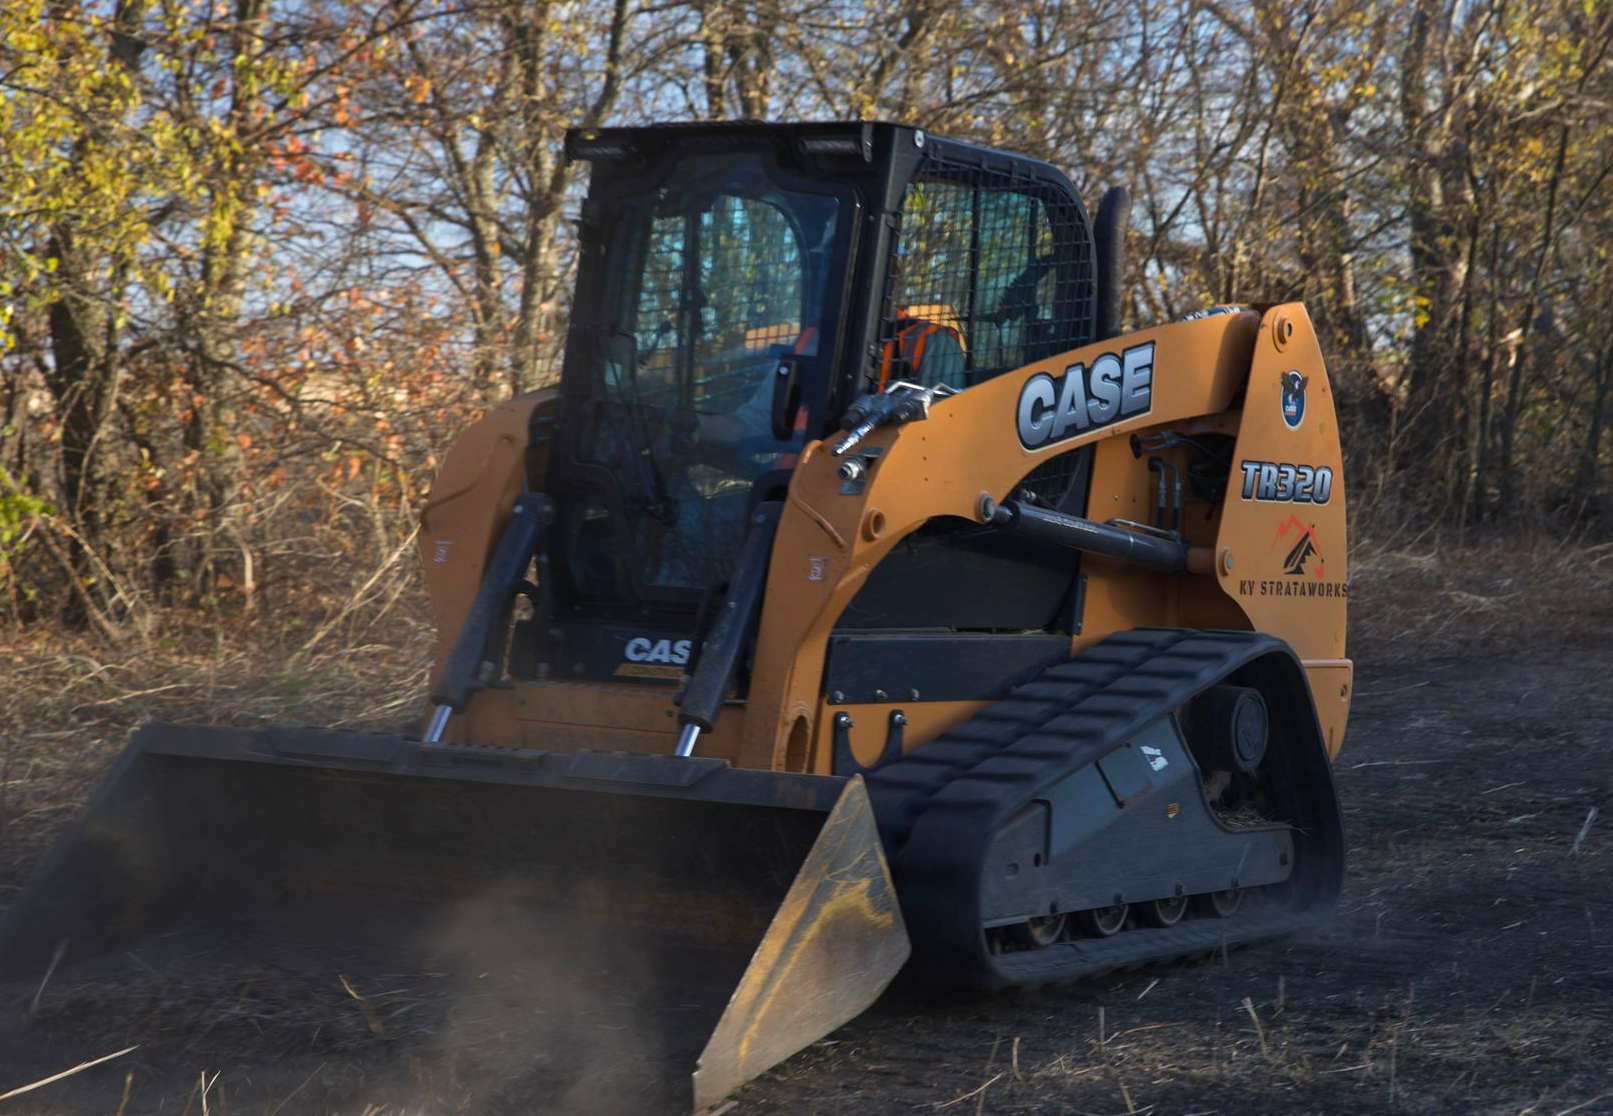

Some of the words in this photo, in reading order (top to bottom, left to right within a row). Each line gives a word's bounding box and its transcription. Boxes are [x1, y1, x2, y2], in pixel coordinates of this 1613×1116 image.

[1016, 340, 1155, 449] CASE
[1241, 460, 1333, 504] TR320
[1240, 580, 1255, 596] KV
[1260, 580, 1347, 597] STRATAWORKS
[624, 636, 692, 665] CAS
